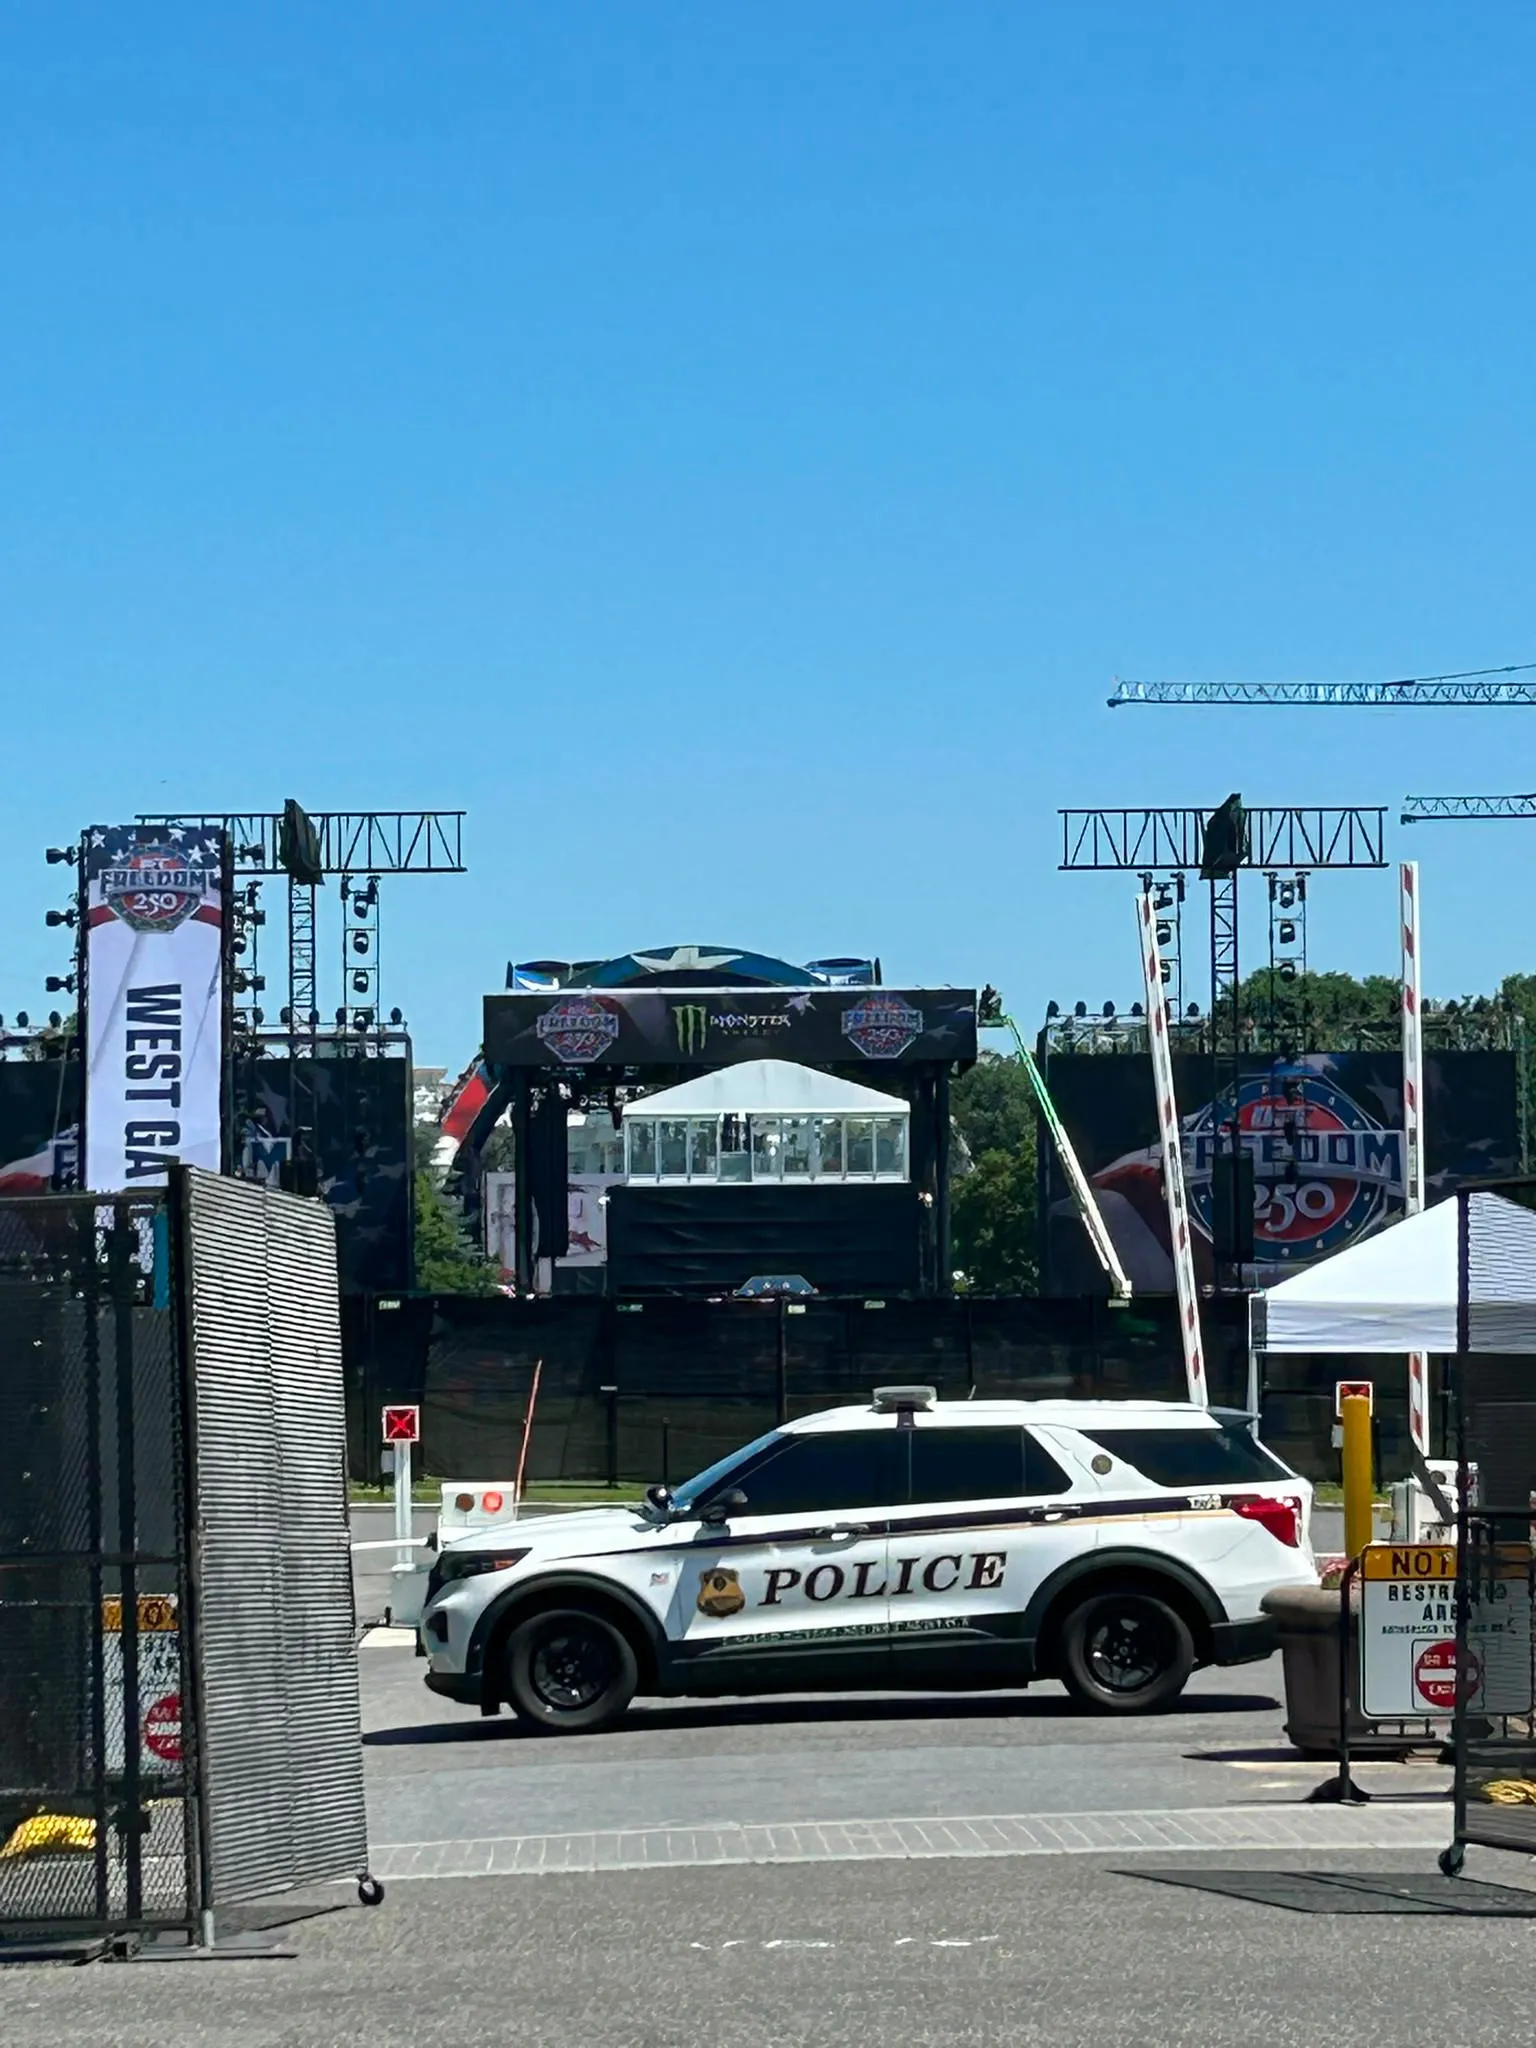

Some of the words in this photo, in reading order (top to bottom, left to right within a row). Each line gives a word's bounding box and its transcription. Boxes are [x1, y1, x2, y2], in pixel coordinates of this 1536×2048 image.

[133, 893, 177, 918] 250
[125, 984, 182, 1109] WEST
[1253, 1182, 1335, 1232] 250
[757, 1551, 1007, 1607] POLICE
